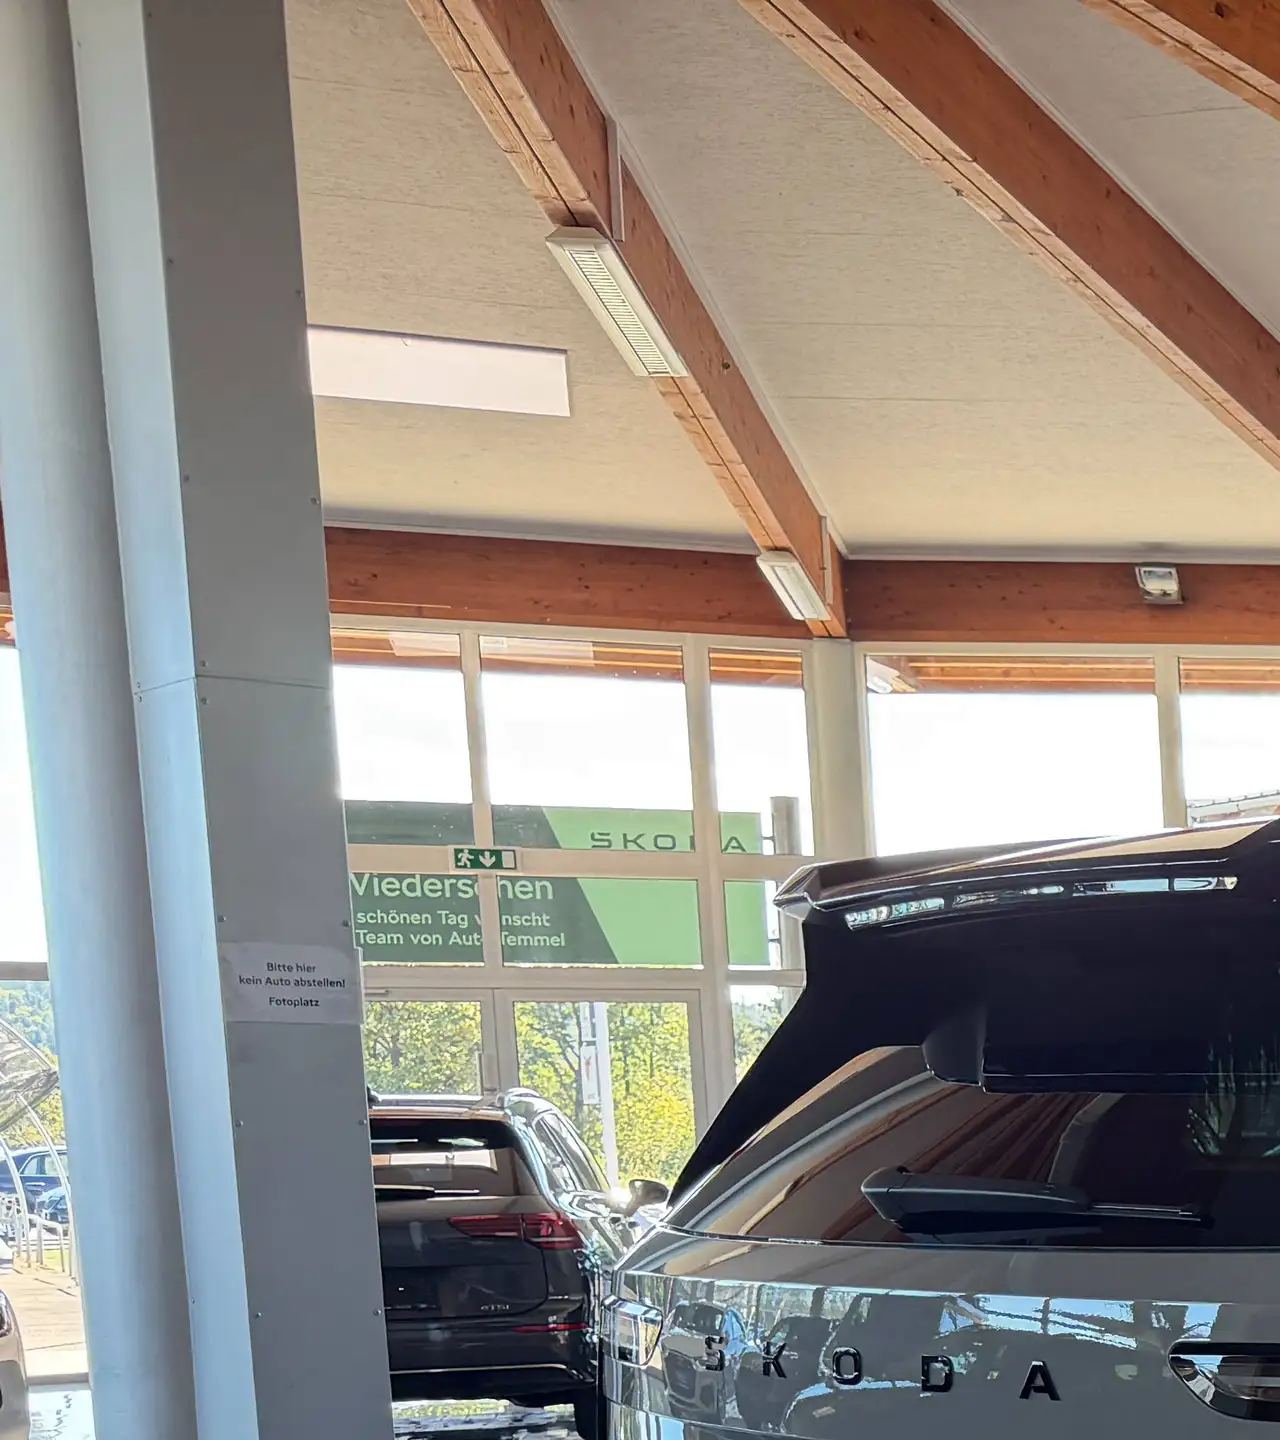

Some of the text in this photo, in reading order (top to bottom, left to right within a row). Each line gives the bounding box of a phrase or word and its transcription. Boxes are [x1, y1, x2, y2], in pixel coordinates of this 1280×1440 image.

[590, 832, 747, 853] SKOA
[349, 873, 554, 899] iedershen
[356, 909, 551, 928] schönen Tag nscht
[356, 929, 566, 947] Team von Aut Temmel
[266, 962, 317, 973] Bitte hier
[238, 975, 346, 988] kein Auto abstellen!
[268, 996, 320, 1008] Fotoplatz
[704, 1335, 1062, 1402] SKODA
